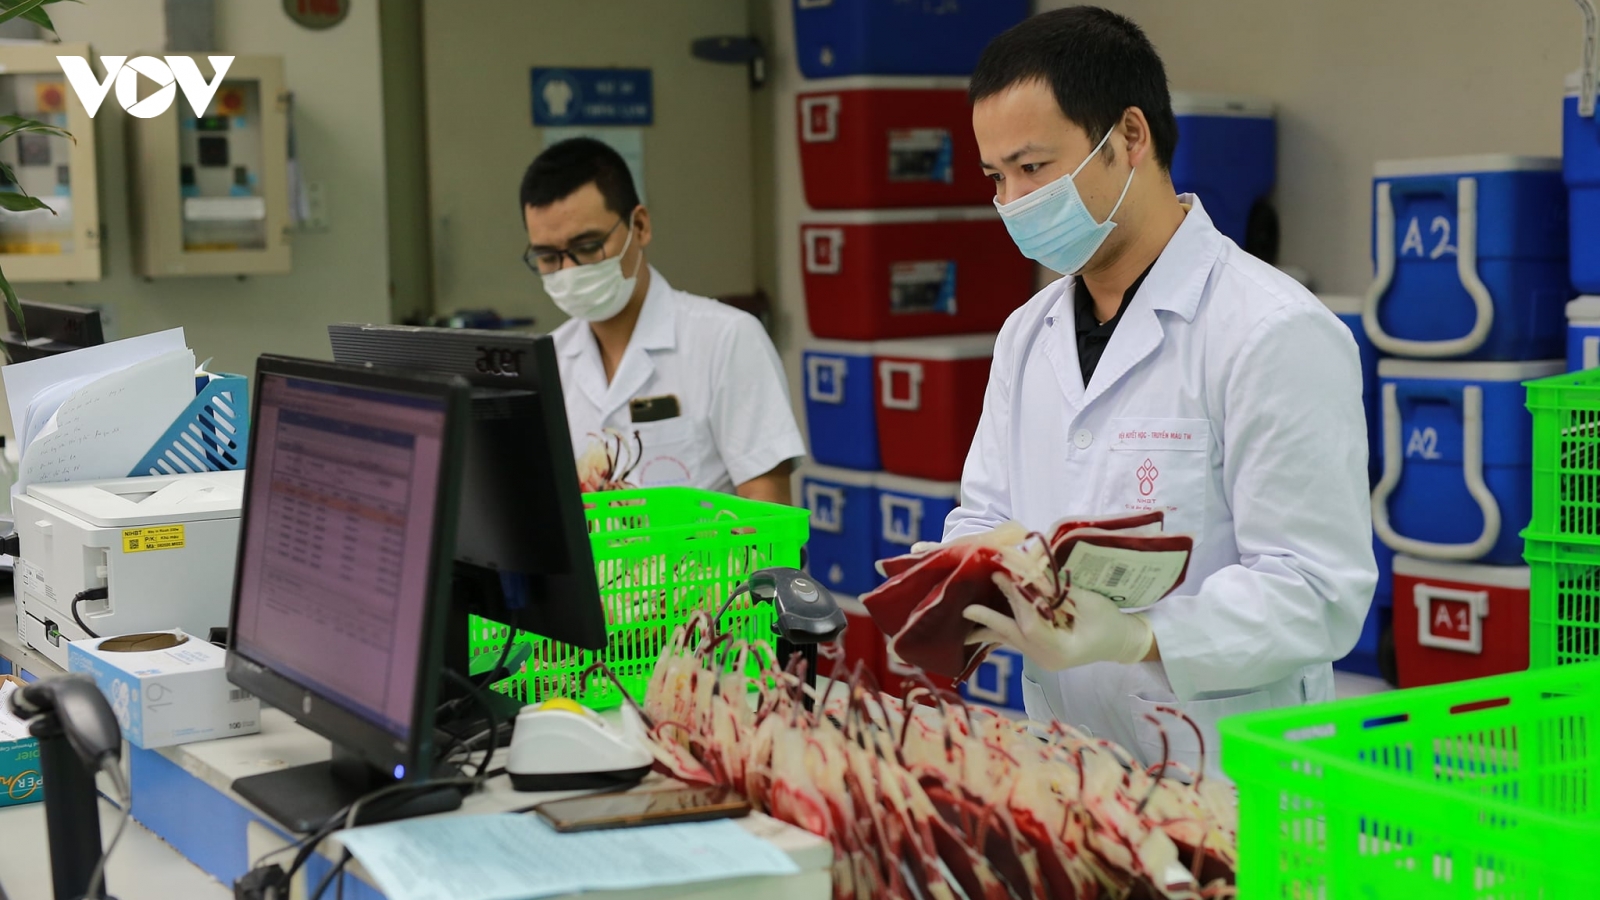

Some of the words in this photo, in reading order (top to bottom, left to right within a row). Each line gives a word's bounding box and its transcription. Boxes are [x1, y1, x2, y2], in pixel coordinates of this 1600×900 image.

[475, 346, 527, 377] acer
[1405, 426, 1443, 460] A2
[1434, 603, 1471, 632] A1
[15, 748, 41, 761] pier
[17, 775, 43, 788] PER
